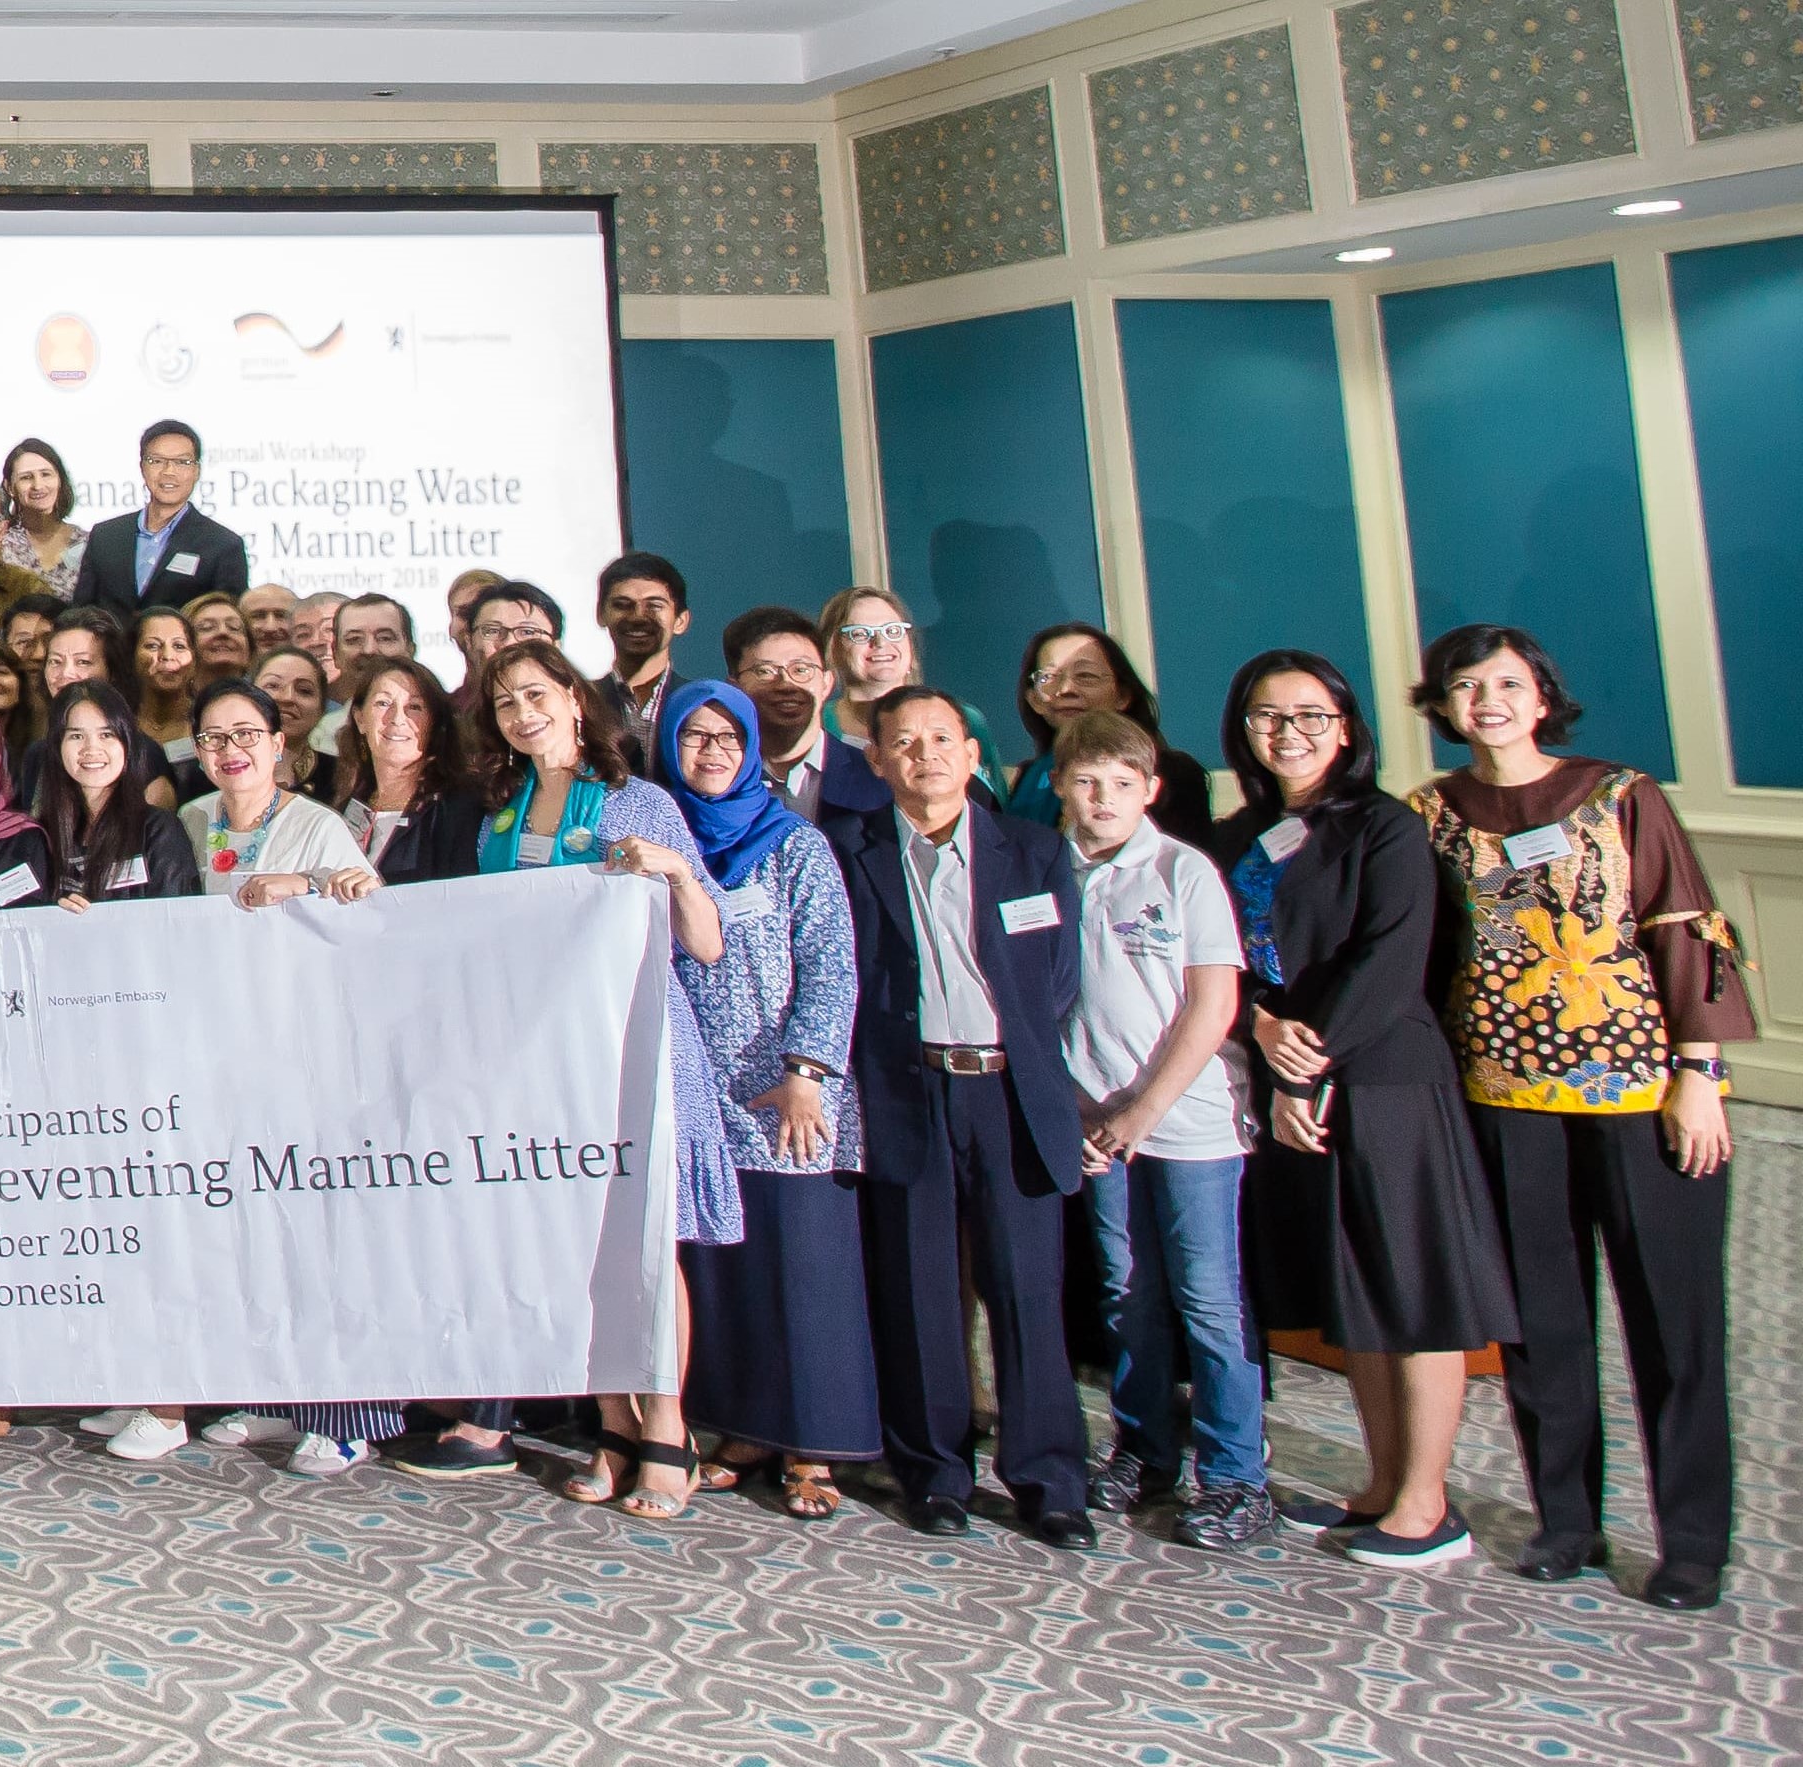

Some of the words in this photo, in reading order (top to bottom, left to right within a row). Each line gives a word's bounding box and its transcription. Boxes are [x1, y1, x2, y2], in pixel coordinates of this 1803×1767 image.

[268, 442, 366, 465] Workshop
[229, 470, 407, 516] Packaging
[415, 468, 522, 505] Waste
[271, 521, 395, 559] Marine
[408, 520, 502, 558] Litter
[281, 566, 386, 589] November
[392, 567, 439, 588] 2018
[47, 994, 112, 1008] Norwegian
[114, 989, 168, 1004] Embassy
[141, 1094, 182, 1133] of
[247, 1139, 453, 1195] Marine
[467, 1131, 634, 1184] Litter
[59, 1225, 142, 1257] 2018
